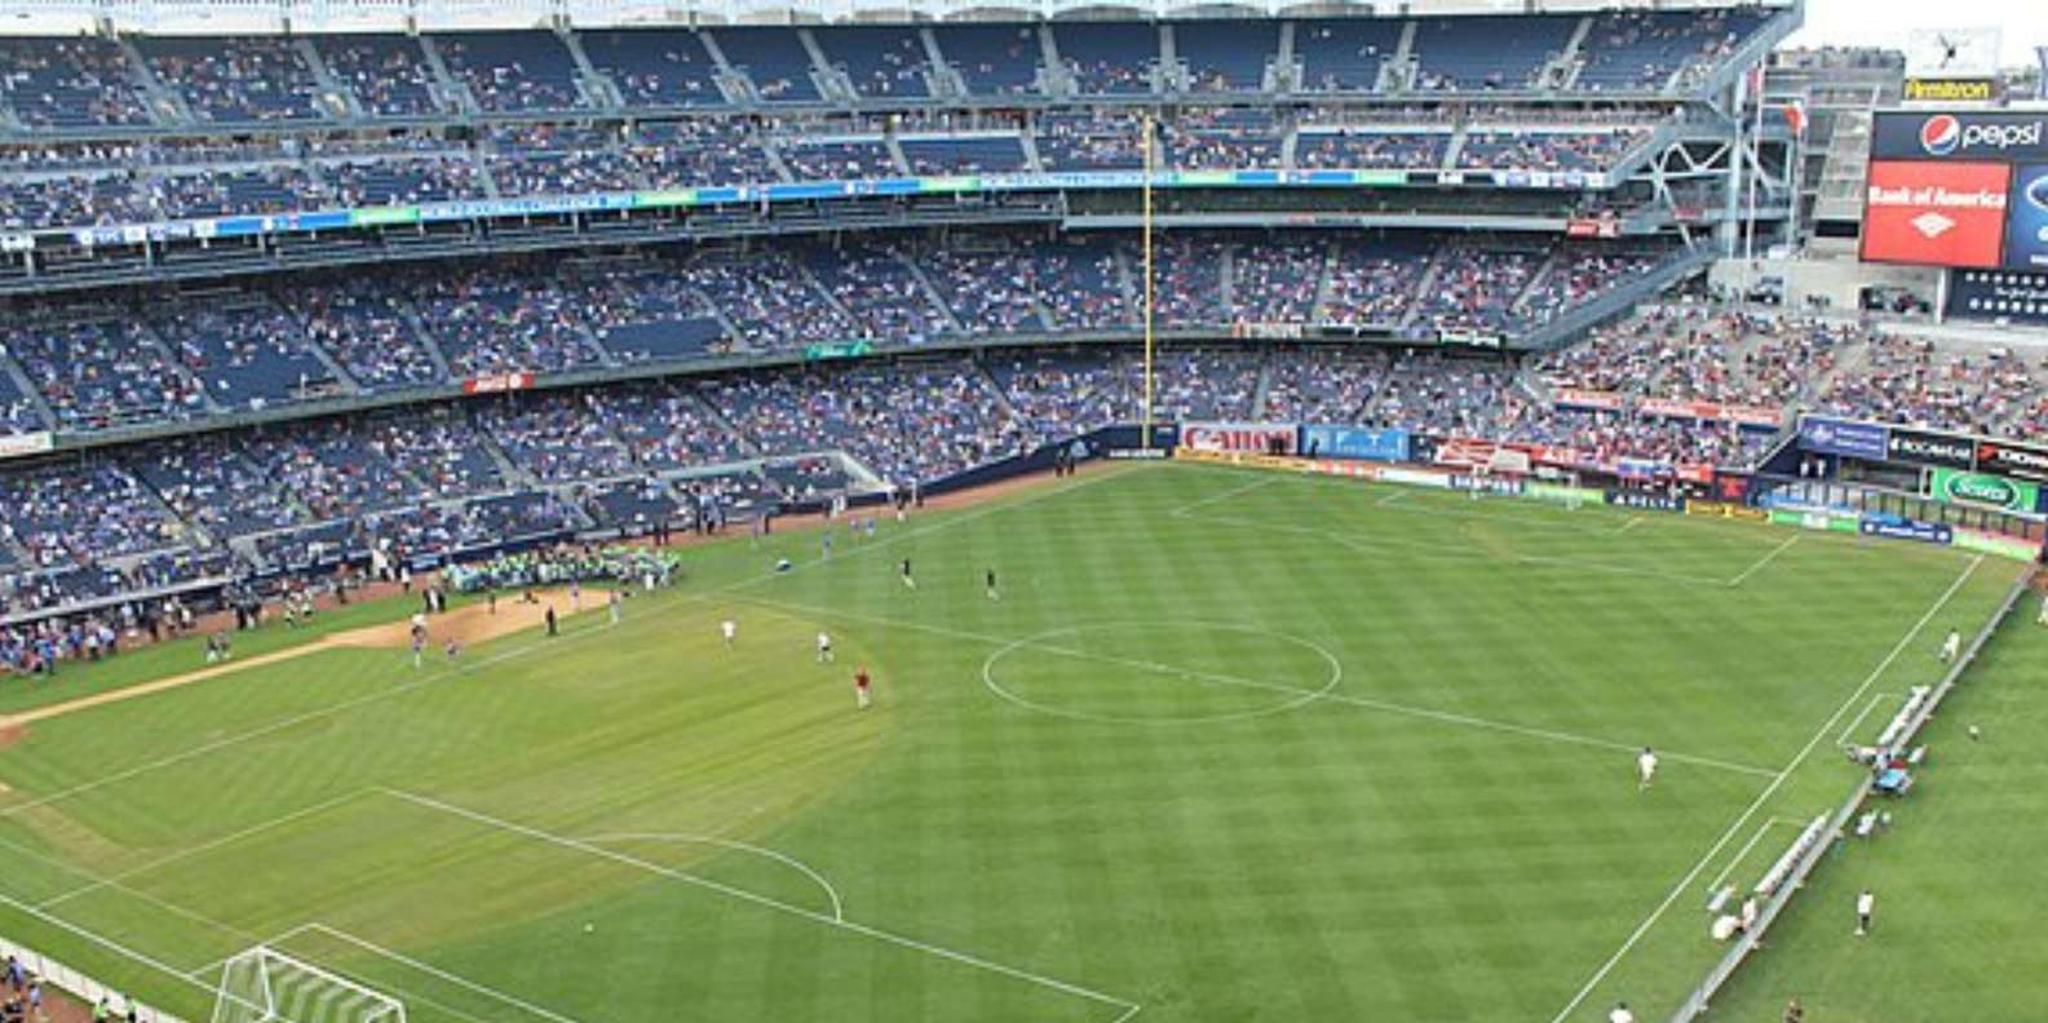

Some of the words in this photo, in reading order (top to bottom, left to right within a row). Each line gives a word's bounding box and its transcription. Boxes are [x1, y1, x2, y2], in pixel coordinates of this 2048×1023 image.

[1904, 78, 1988, 99] Armitron
[1962, 121, 2042, 149] pepsi
[1869, 185, 1909, 206] Bank
[1914, 186, 1935, 206] of
[1934, 186, 2007, 209] America
[1184, 426, 1294, 451] Canon
